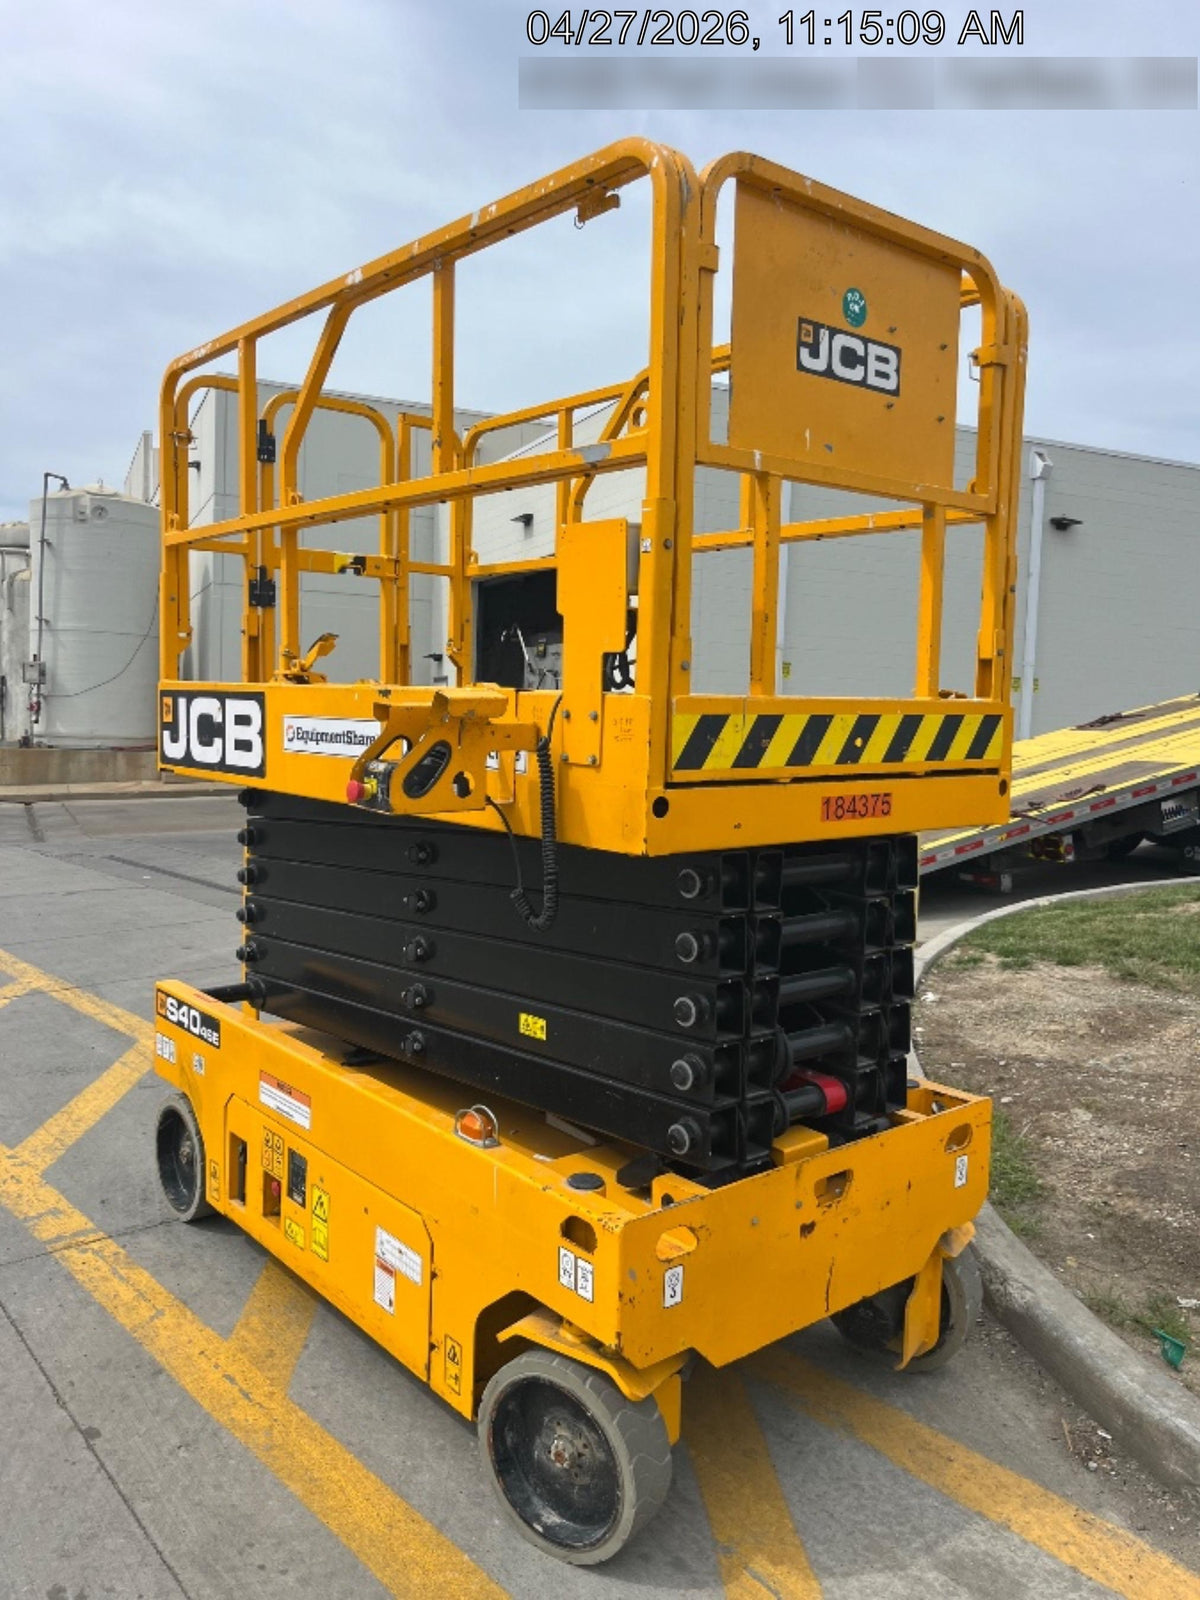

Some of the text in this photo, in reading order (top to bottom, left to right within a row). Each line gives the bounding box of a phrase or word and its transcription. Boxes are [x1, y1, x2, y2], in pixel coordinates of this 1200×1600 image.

[800, 328, 899, 390] JCB
[162, 697, 262, 769] JCB
[295, 725, 376, 746] EquipmentShare
[823, 792, 892, 820] 184375
